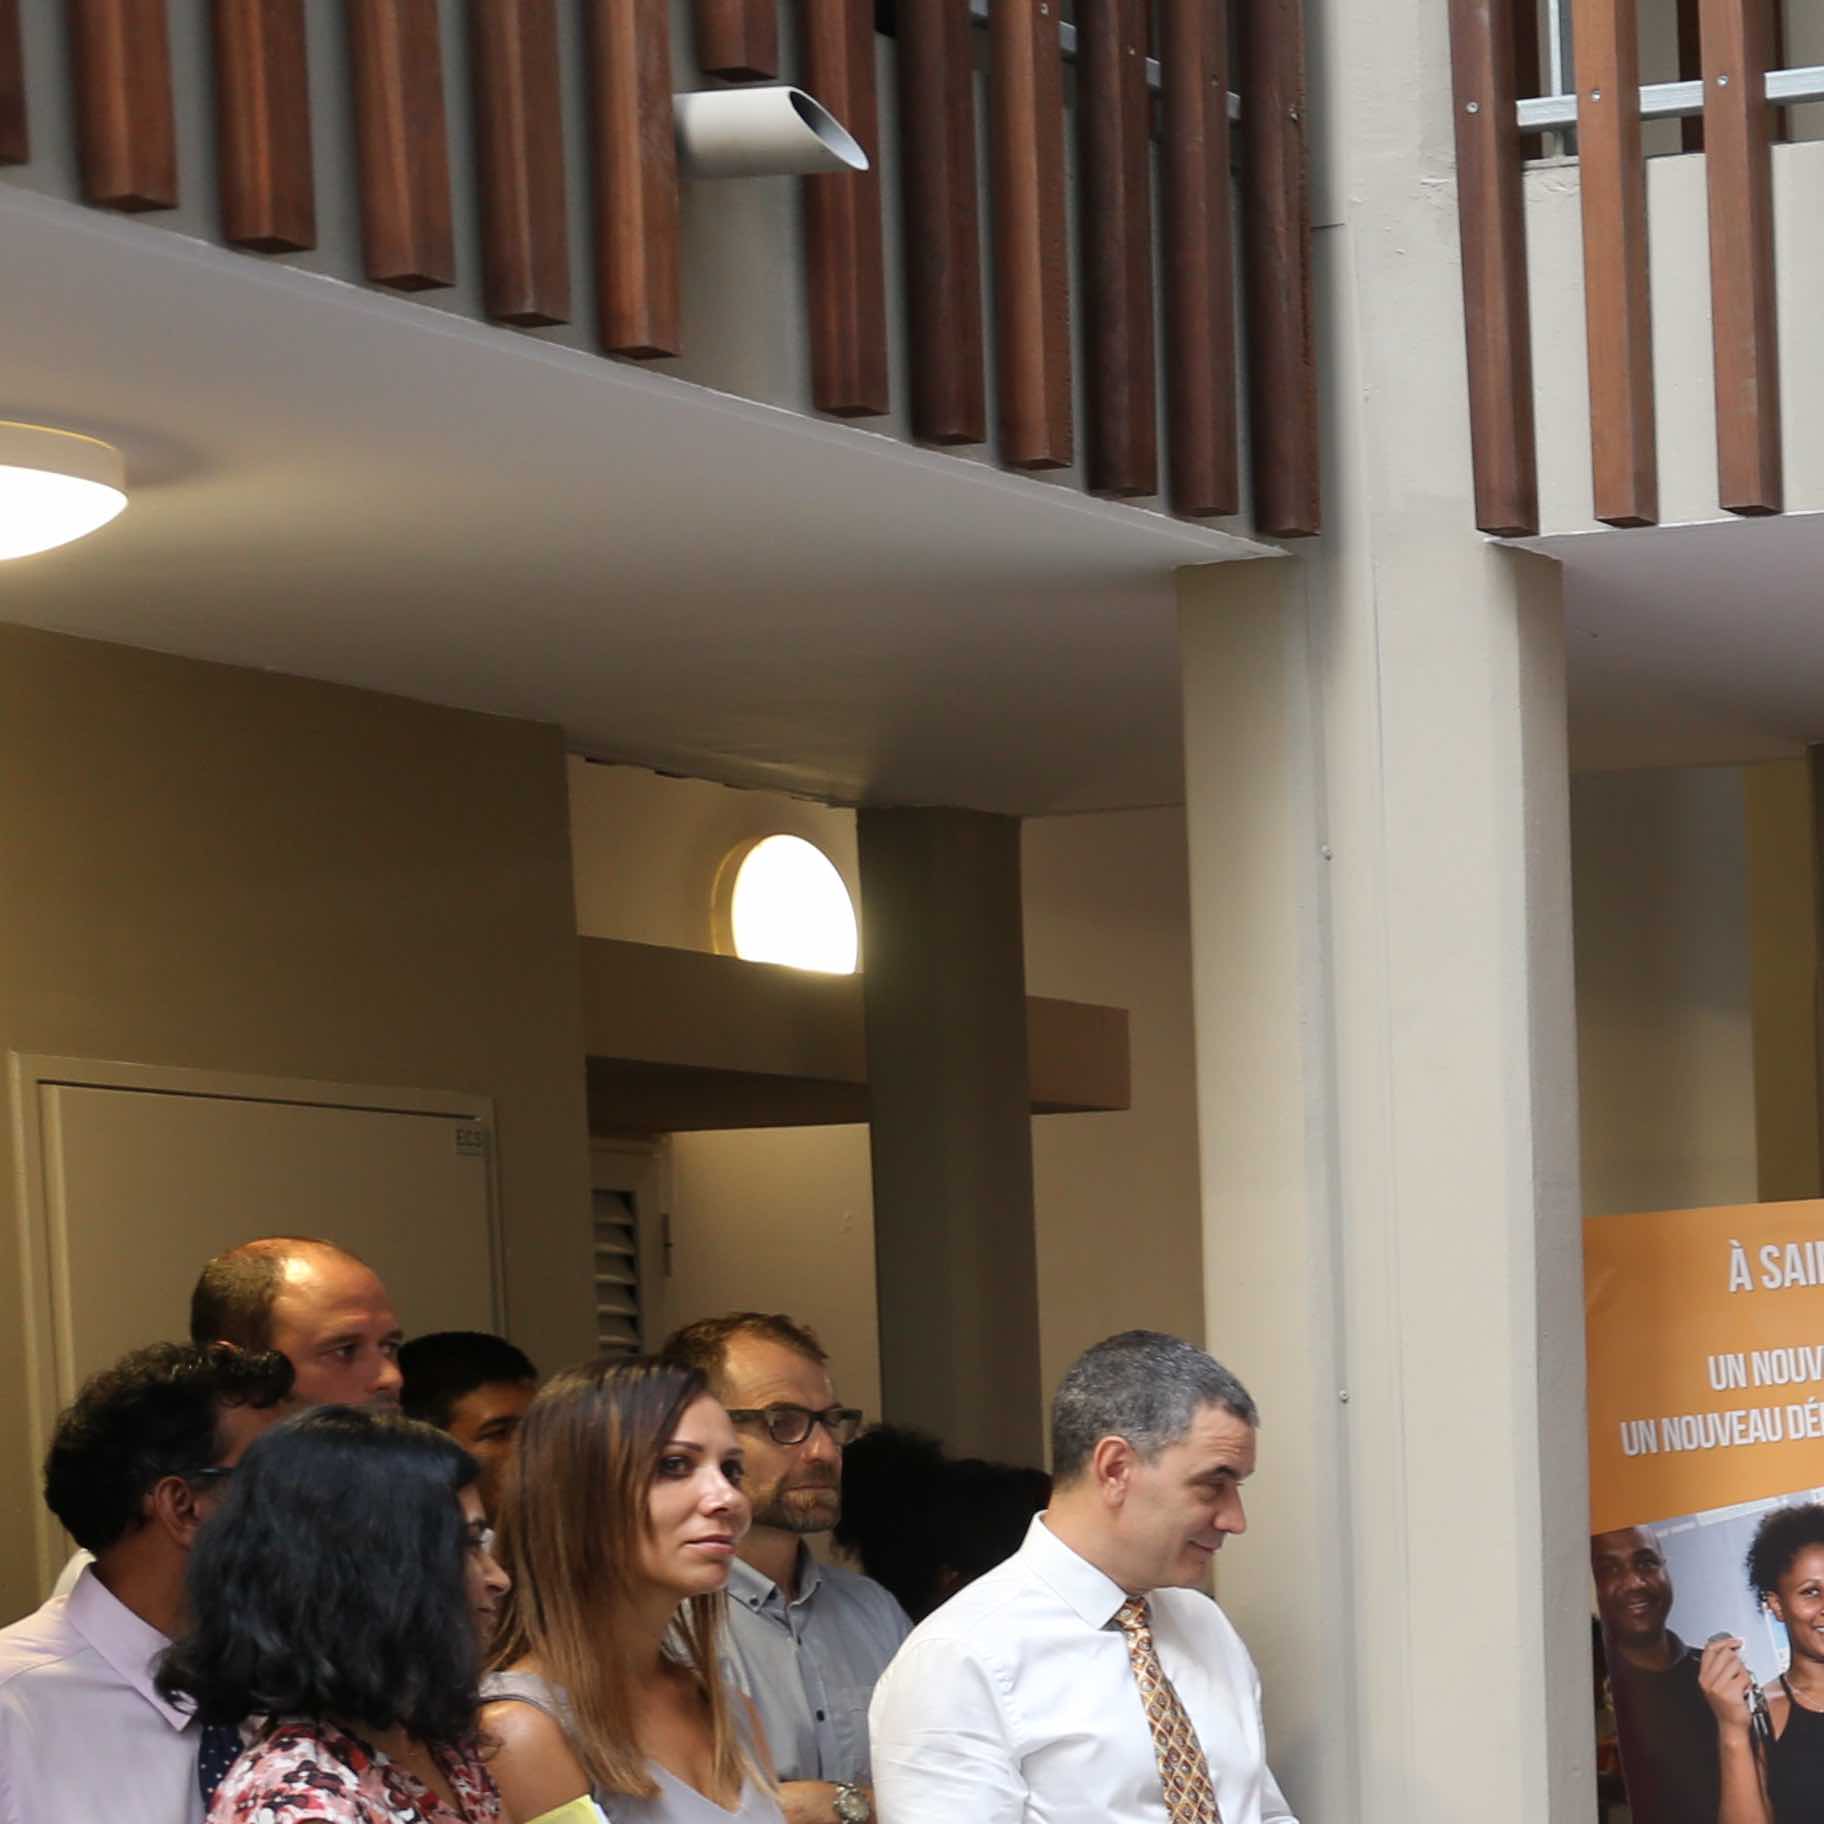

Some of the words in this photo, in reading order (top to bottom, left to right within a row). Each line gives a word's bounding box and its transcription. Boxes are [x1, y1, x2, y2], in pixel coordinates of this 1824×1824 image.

[1729, 1240, 1752, 1292] À
[1708, 1354, 1746, 1391] UN
[1620, 1420, 1658, 1456] UN
[1662, 1408, 1783, 1454] NOUVEAU
